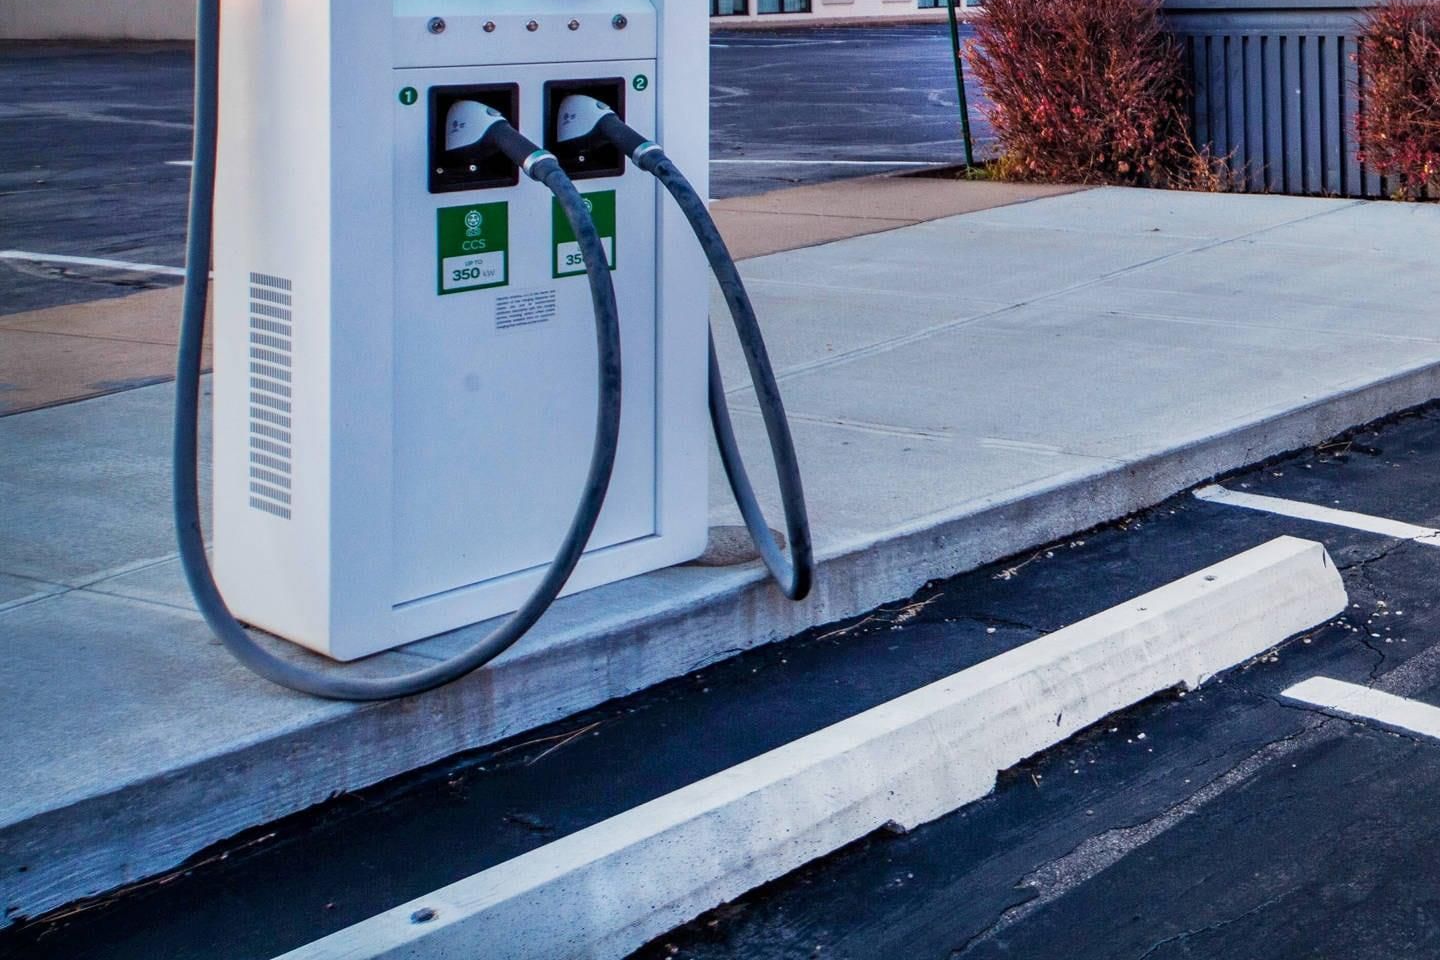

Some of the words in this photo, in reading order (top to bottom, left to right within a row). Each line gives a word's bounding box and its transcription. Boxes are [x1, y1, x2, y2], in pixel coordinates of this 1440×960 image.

[462, 239, 486, 251] CCS
[566, 253, 584, 266] 35
[452, 267, 480, 281] 350
